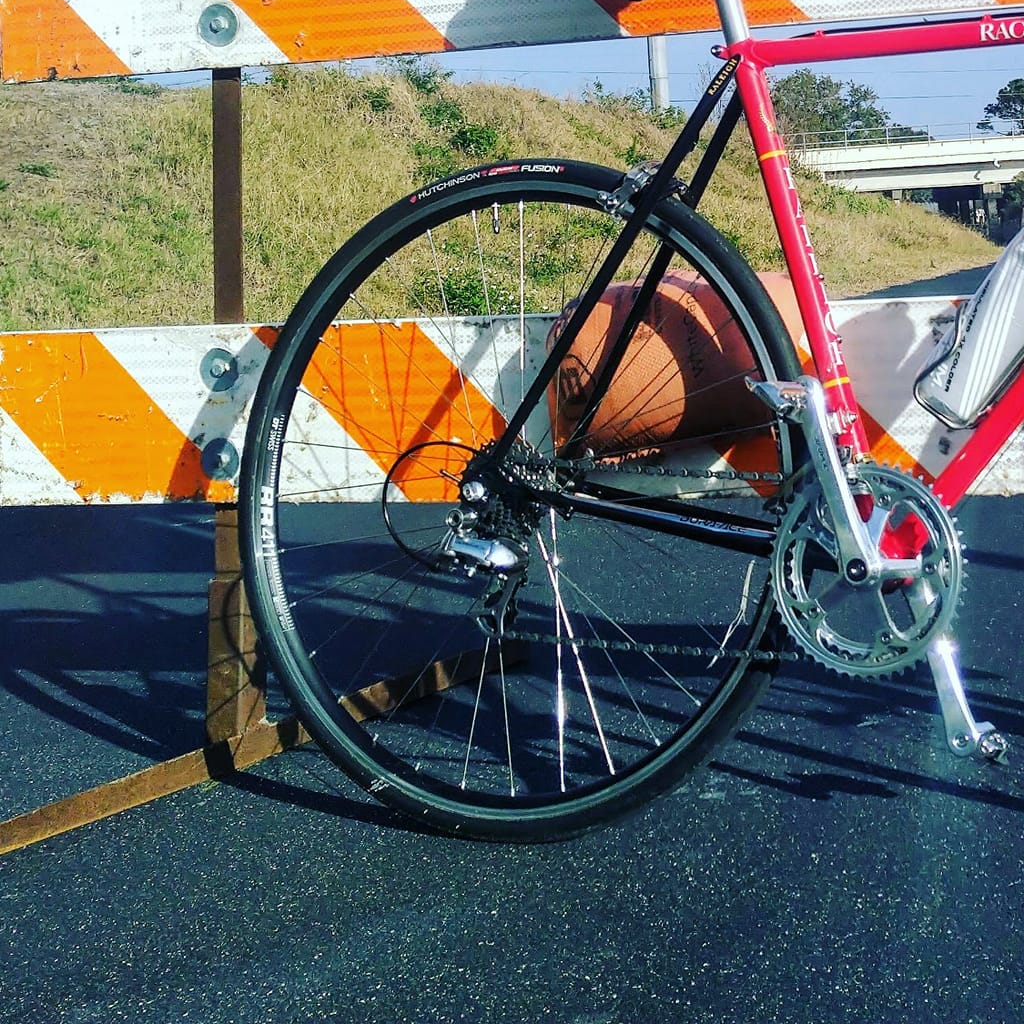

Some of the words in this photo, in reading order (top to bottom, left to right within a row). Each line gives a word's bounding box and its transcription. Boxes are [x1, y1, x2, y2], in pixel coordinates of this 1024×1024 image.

[707, 58, 738, 96] RALEIGH
[417, 170, 482, 200] HUTCHINSON
[266, 430, 278, 452] SWISS
